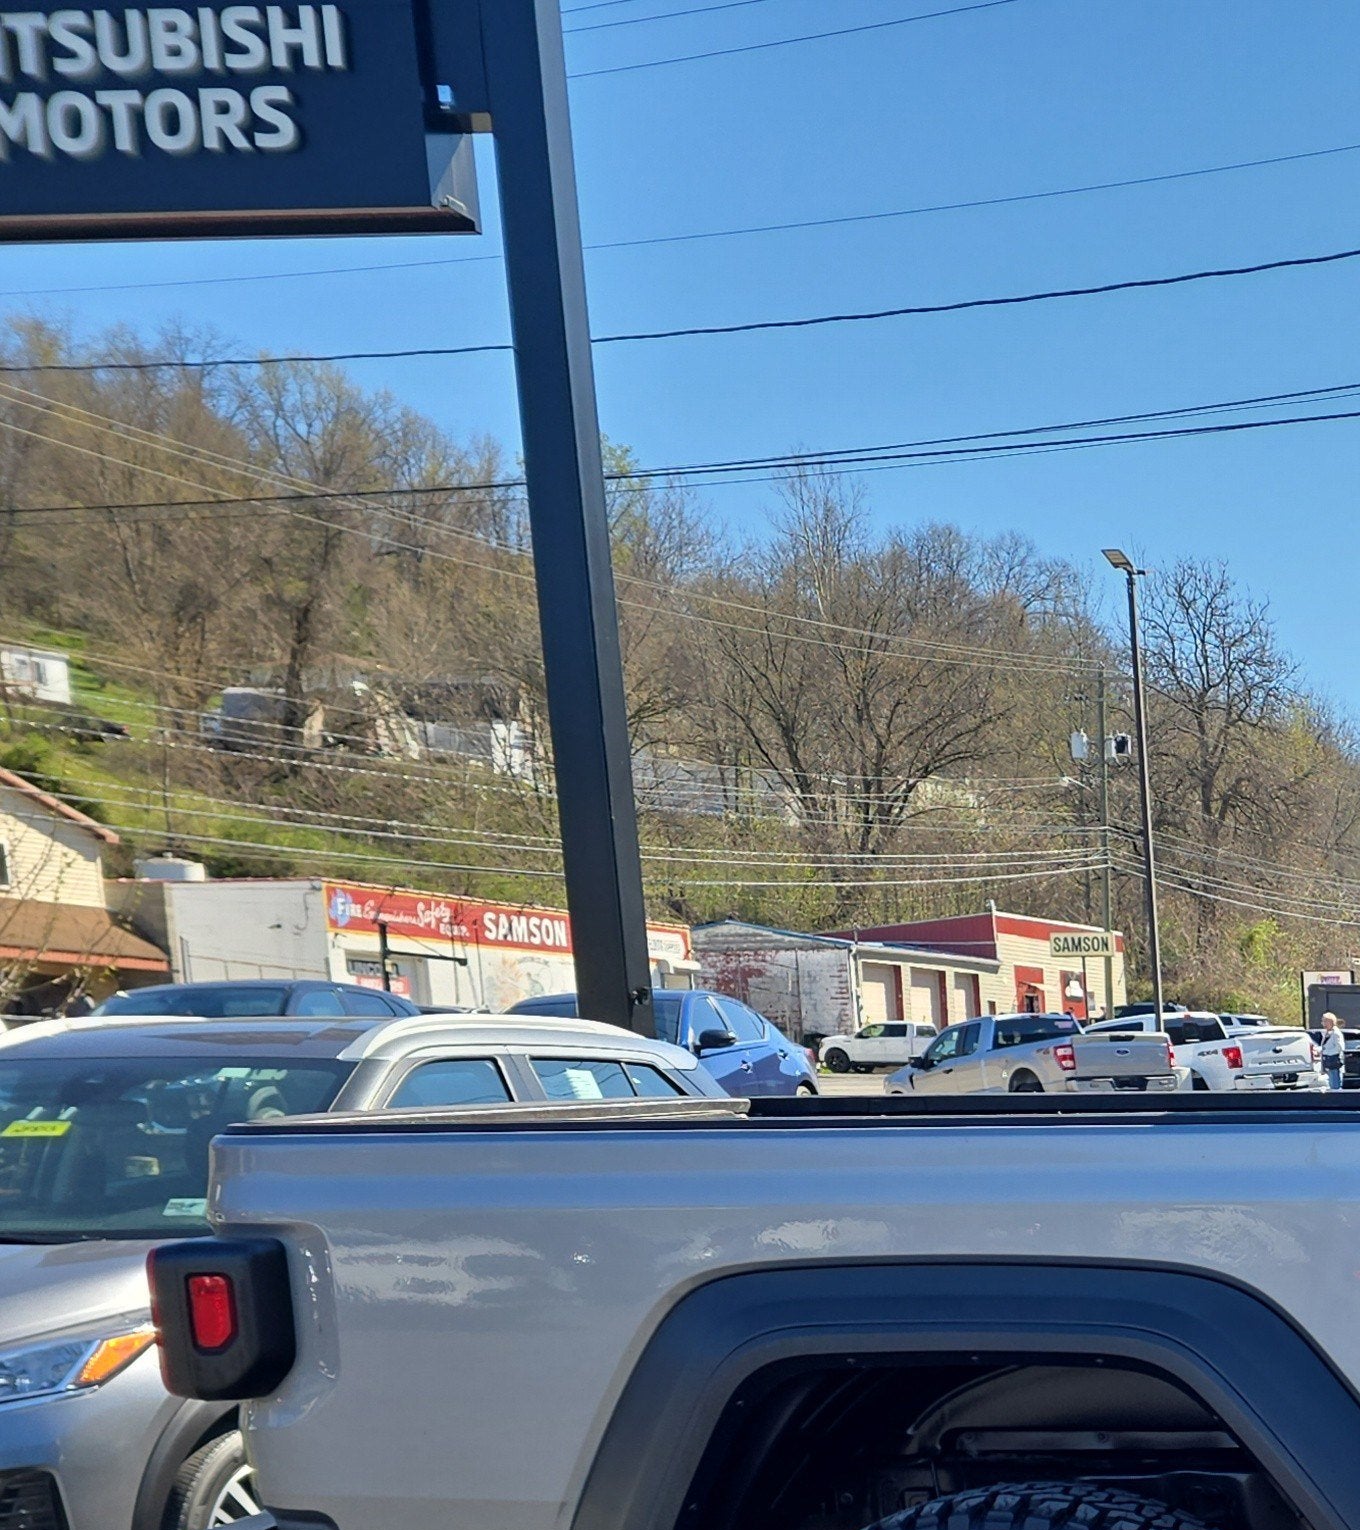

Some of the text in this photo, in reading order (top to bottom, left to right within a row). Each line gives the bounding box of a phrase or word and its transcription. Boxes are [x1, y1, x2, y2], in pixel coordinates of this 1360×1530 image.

[0, 85, 300, 156] MOTORS
[483, 911, 569, 947] SAMSON
[1053, 936, 1109, 952] SAMSON
